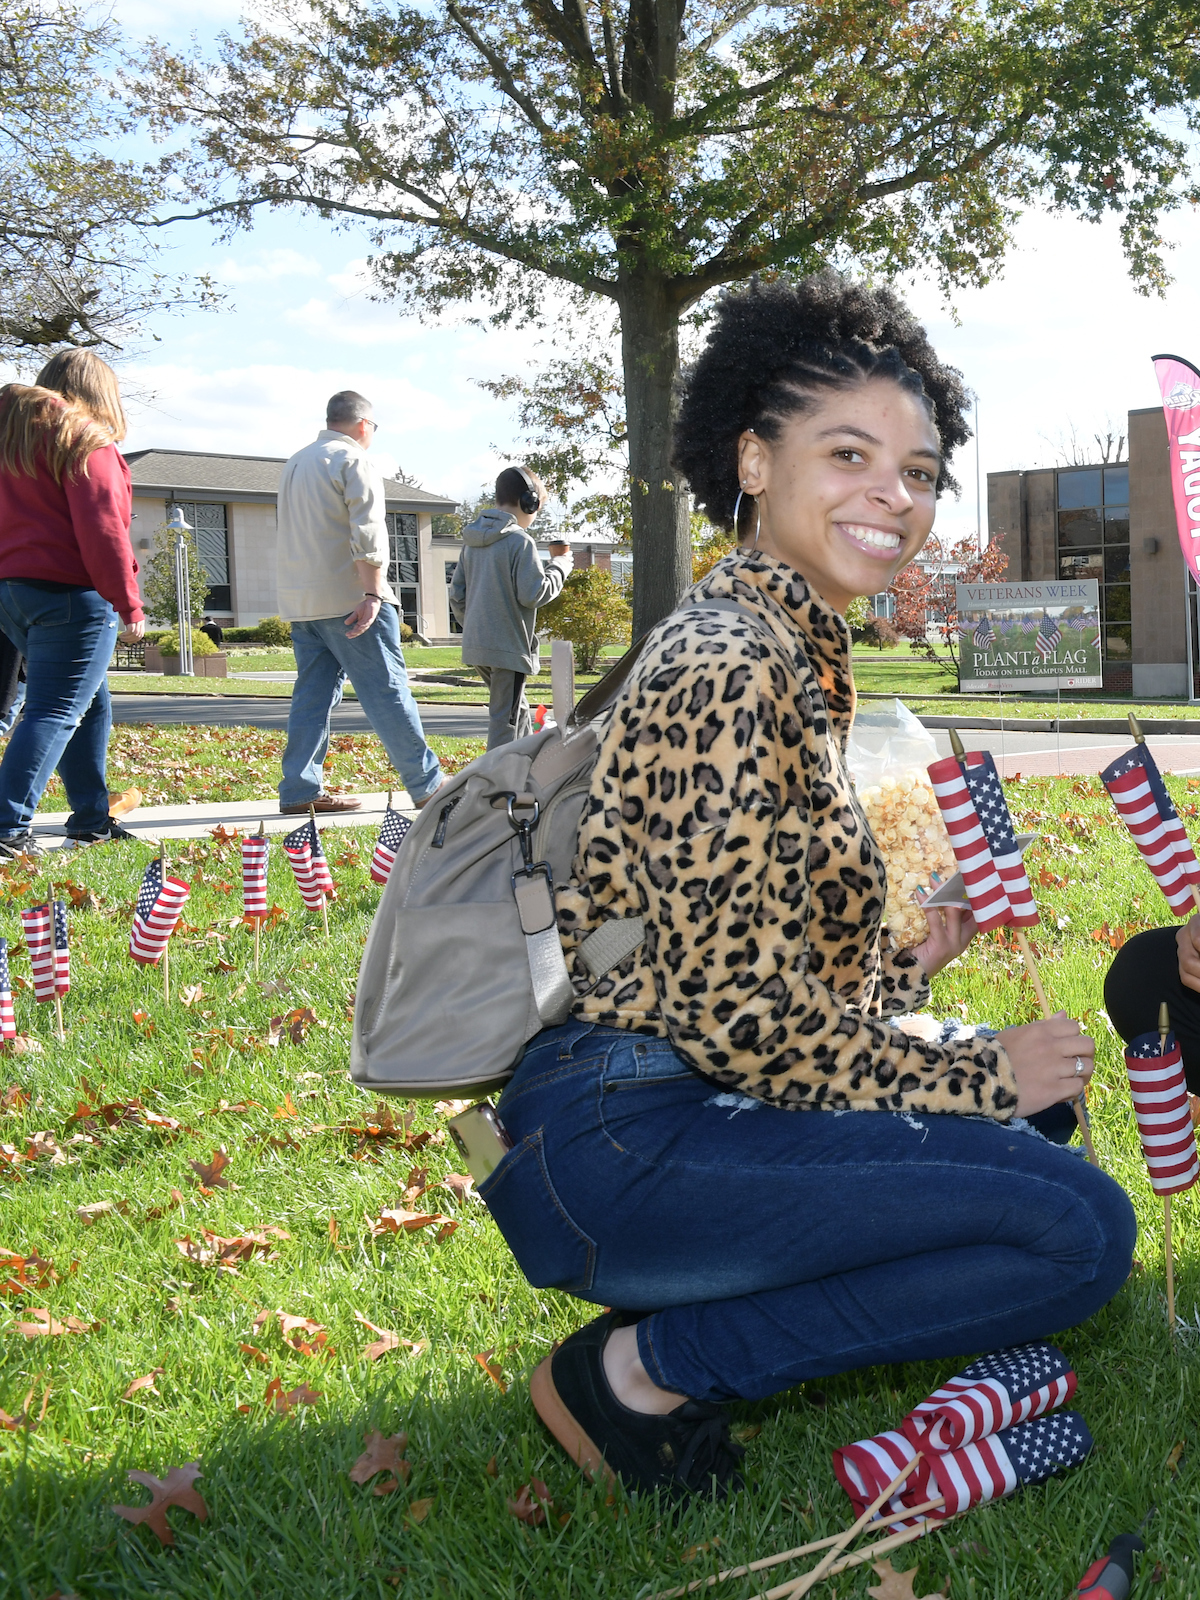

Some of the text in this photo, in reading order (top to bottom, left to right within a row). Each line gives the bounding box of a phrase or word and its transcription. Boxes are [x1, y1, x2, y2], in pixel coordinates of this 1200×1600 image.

[967, 585, 1088, 600] VETERANS WEEK
[973, 649, 1087, 667] PLANT a FLAG
